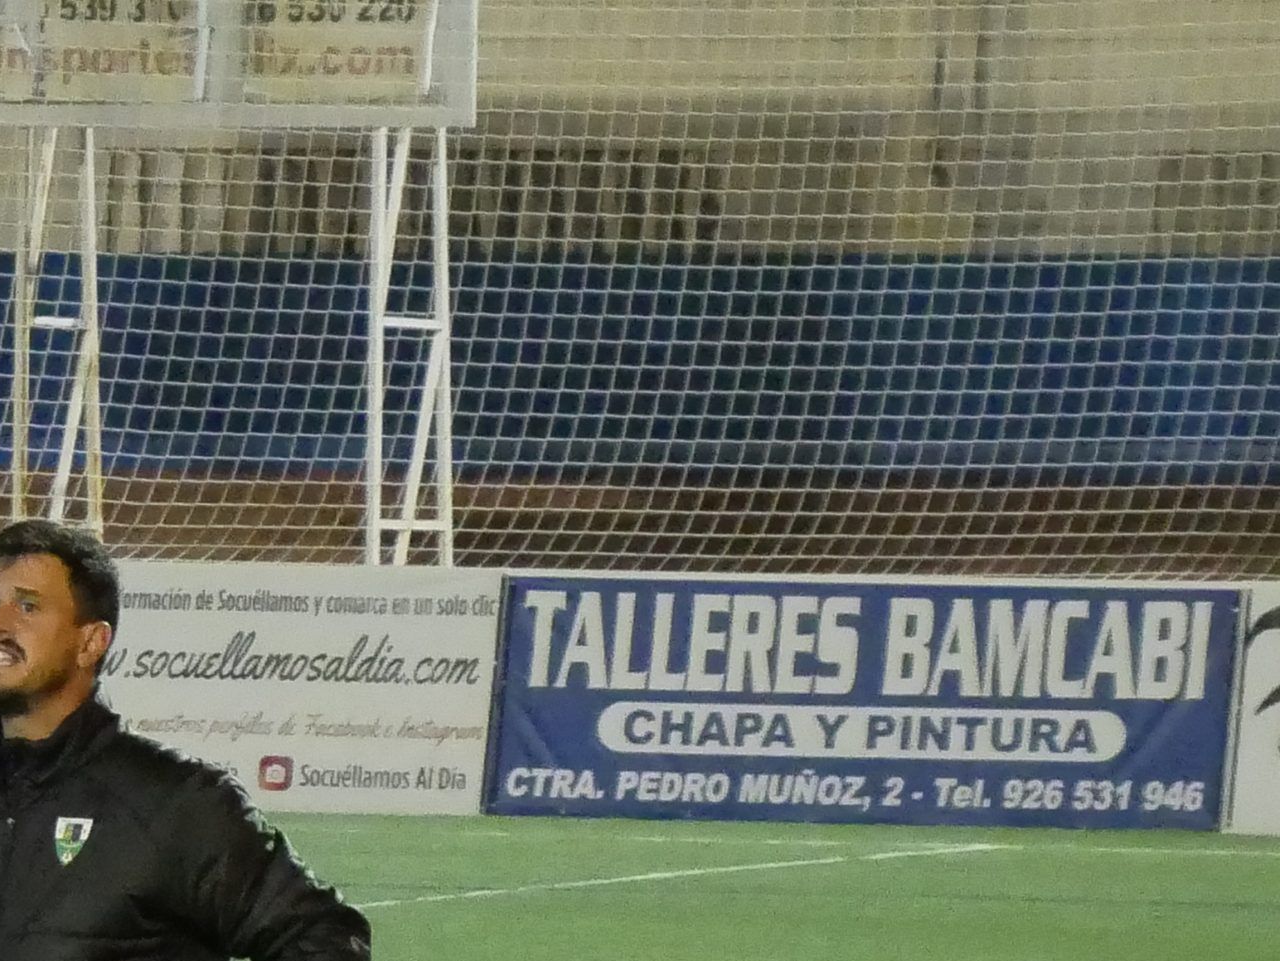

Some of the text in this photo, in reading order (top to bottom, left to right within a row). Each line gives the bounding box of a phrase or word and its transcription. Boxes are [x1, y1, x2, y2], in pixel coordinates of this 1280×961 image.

[195, 590, 213, 611] de
[314, 595, 324, 616] y
[326, 595, 388, 615] comarca
[392, 596, 410, 615] en
[413, 597, 433, 615] un
[436, 595, 468, 616] solo
[524, 590, 1215, 700] TALLERES BAMCABI
[623, 709, 1097, 754] CHAPA Y PINTURA
[299, 764, 410, 789] Socuéllamos
[416, 767, 434, 790] Al
[506, 767, 605, 800] CTRA.
[616, 771, 730, 802] PEDRO
[739, 769, 871, 812] MUÑOZ,
[881, 776, 905, 808] 2
[934, 777, 991, 809] Tel.
[1003, 778, 1064, 810] 926
[1071, 780, 1134, 811] 531
